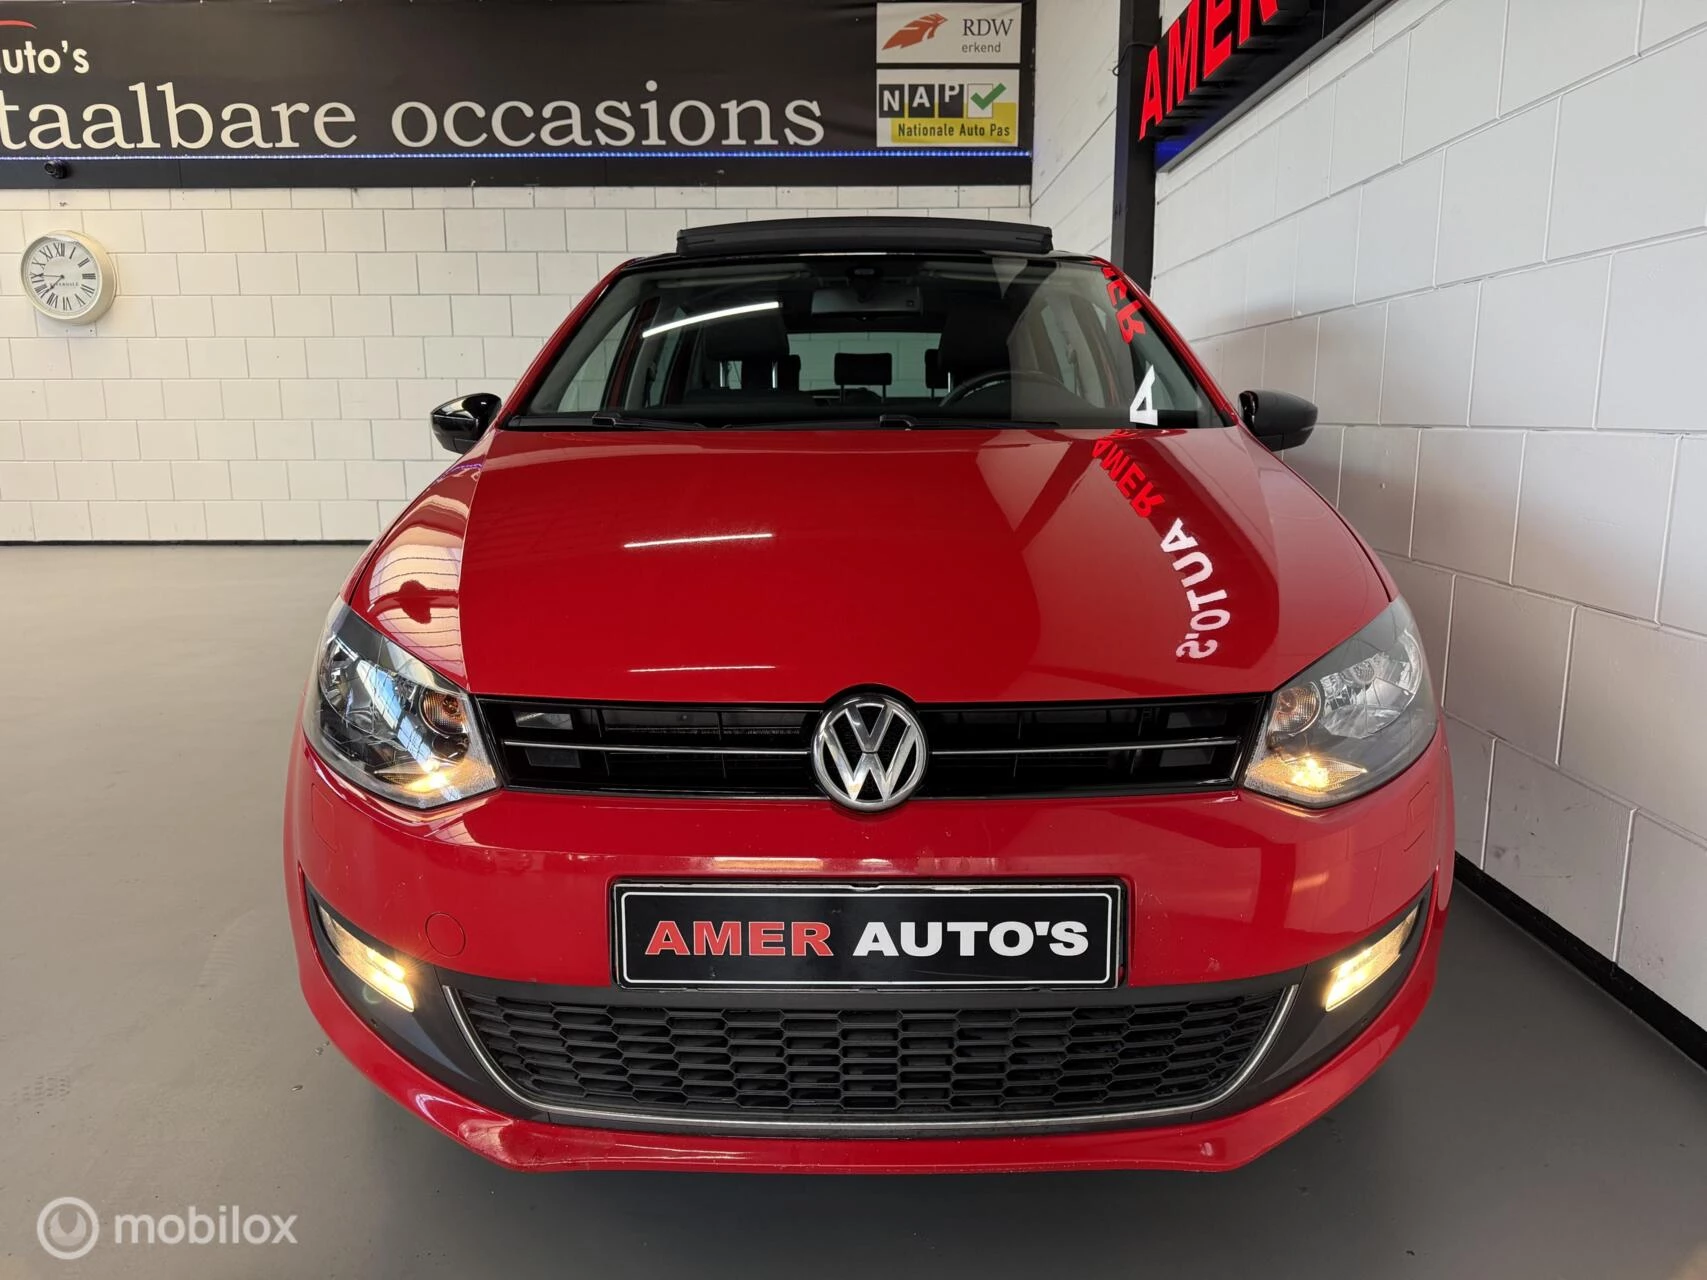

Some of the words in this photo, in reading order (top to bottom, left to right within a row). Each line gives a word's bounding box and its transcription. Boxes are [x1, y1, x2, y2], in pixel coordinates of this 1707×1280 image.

[962, 18, 1014, 37] RDW
[0, 40, 90, 74] uto's
[961, 42, 1001, 53] erkend
[883, 84, 960, 112] NAP
[391, 80, 825, 147] occasions
[898, 123, 954, 137] Nationale
[960, 123, 985, 137] Auto
[990, 123, 1010, 137] Pas
[645, 920, 834, 957] AMER
[852, 920, 1090, 957] AUTO'S
